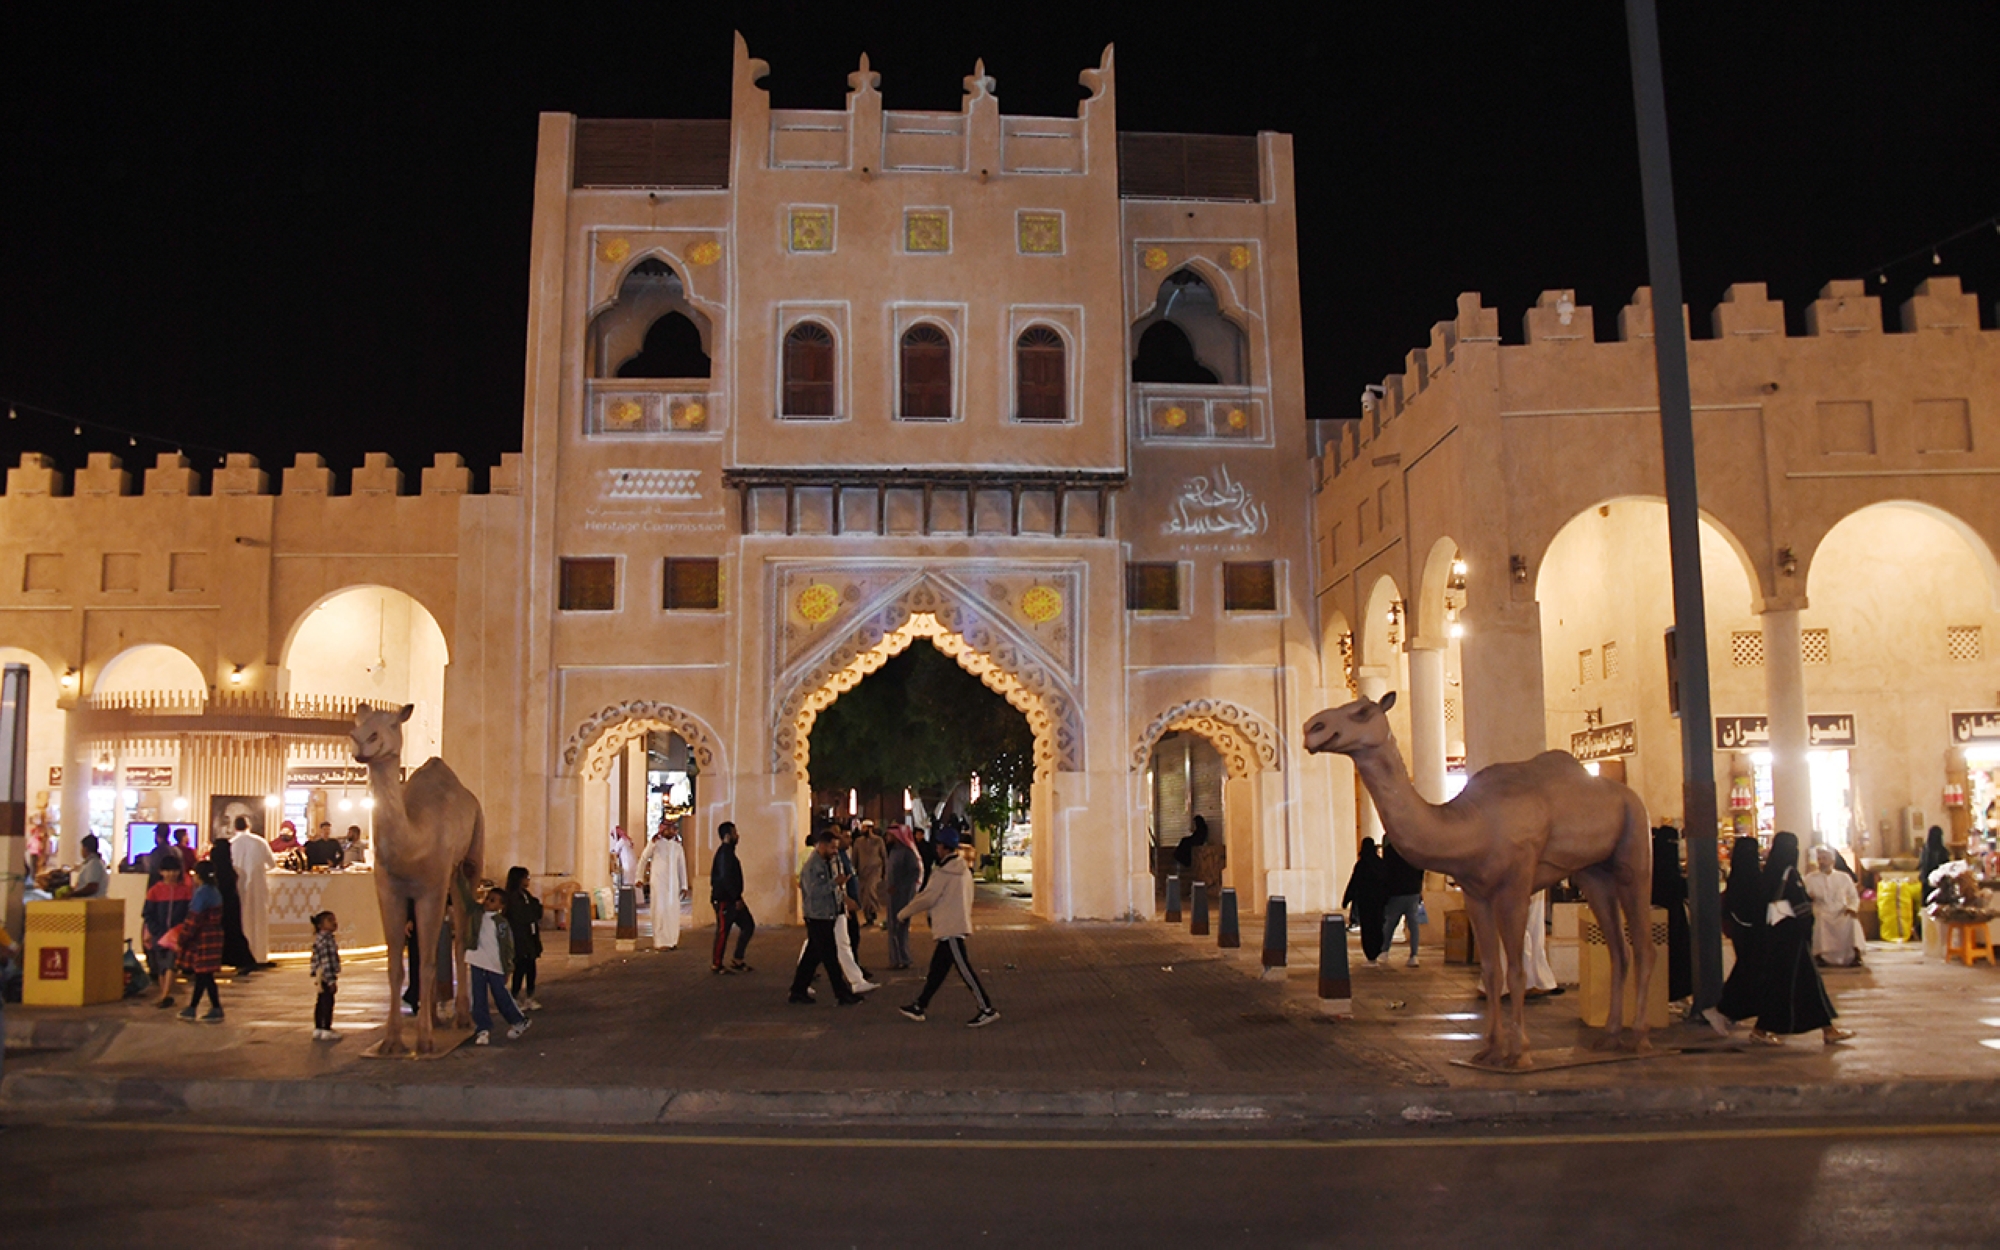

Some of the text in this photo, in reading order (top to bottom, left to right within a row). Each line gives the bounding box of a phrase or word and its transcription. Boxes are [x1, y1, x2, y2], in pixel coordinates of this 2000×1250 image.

[1183, 463, 1245, 510] واحة
[584, 519, 726, 533] Heritage Commission
[1811, 718, 1851, 745] للعو
